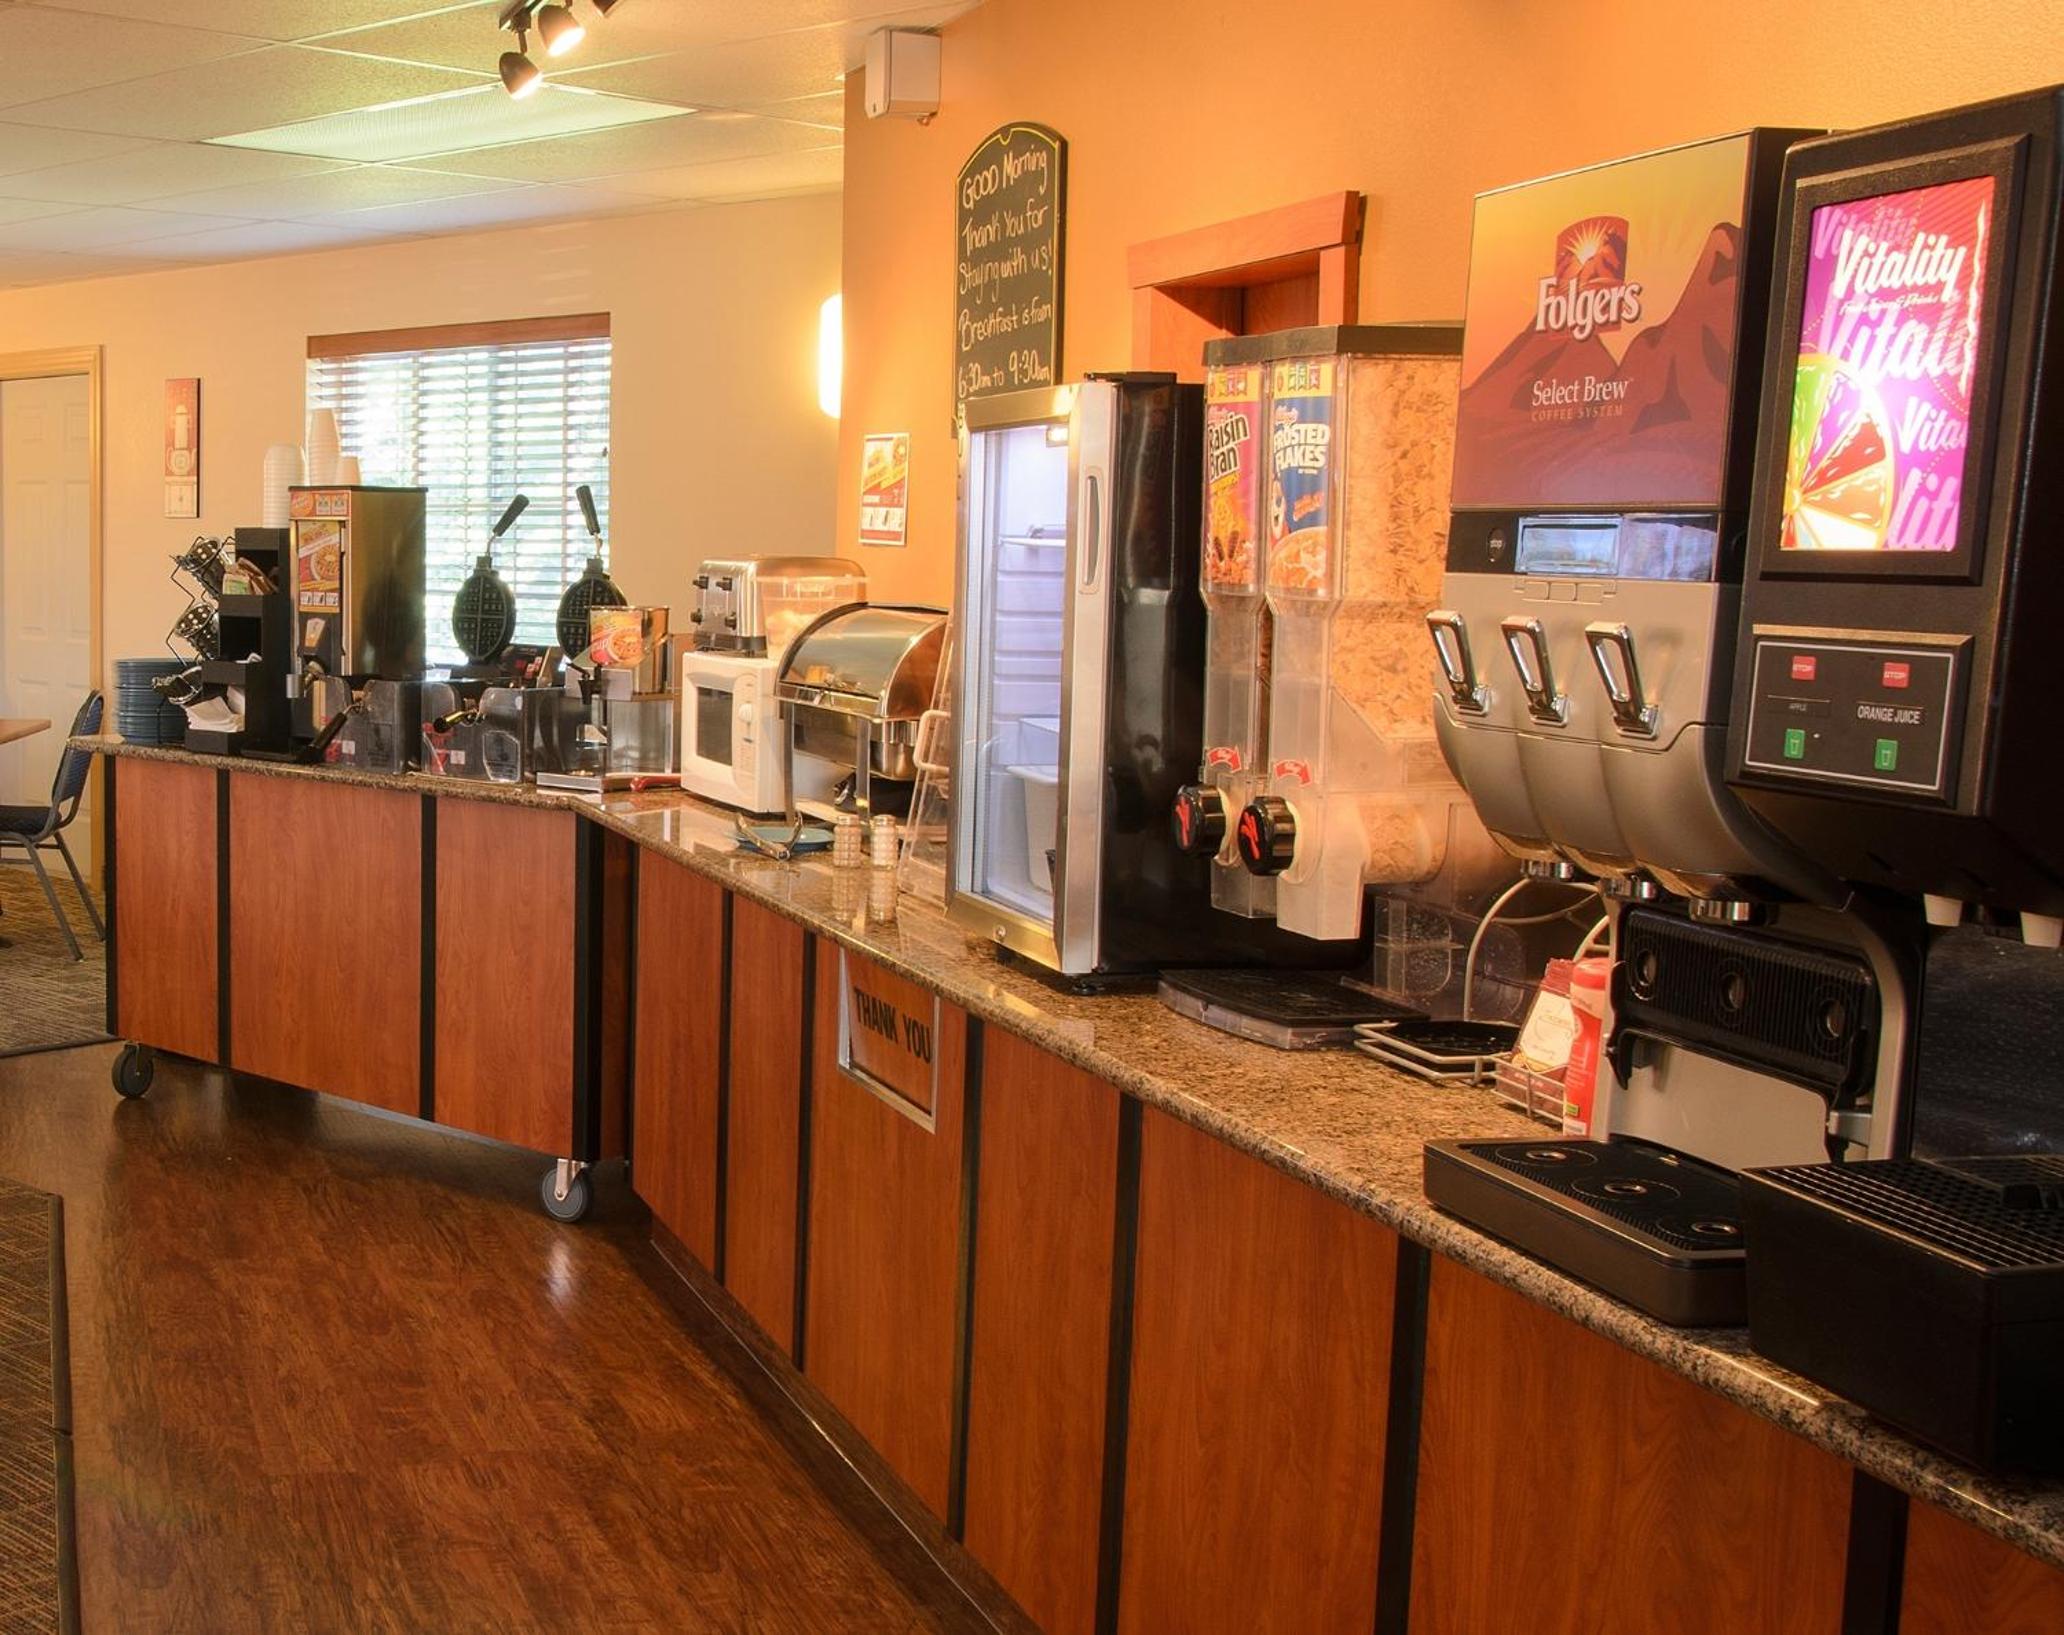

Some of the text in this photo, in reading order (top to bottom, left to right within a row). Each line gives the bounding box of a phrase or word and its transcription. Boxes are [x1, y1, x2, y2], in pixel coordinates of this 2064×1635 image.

[963, 144, 1047, 210] GOOD Morning
[962, 198, 1048, 256] Thank You for
[959, 238, 1052, 304] Staying with us!
[1833, 228, 1968, 303] Vitality
[958, 296, 1051, 351] Breakfast is from
[1535, 276, 1642, 341] Folgers
[993, 366, 1004, 386] to
[1008, 350, 1051, 385] 9:30am
[1532, 375, 1628, 406] Select Brew
[1531, 405, 1623, 422] COFFEE SYSTEM
[1898, 394, 1967, 455] Vita
[1857, 705, 1921, 725] ORANGE JUICE
[854, 986, 932, 1065] THANK YOU
